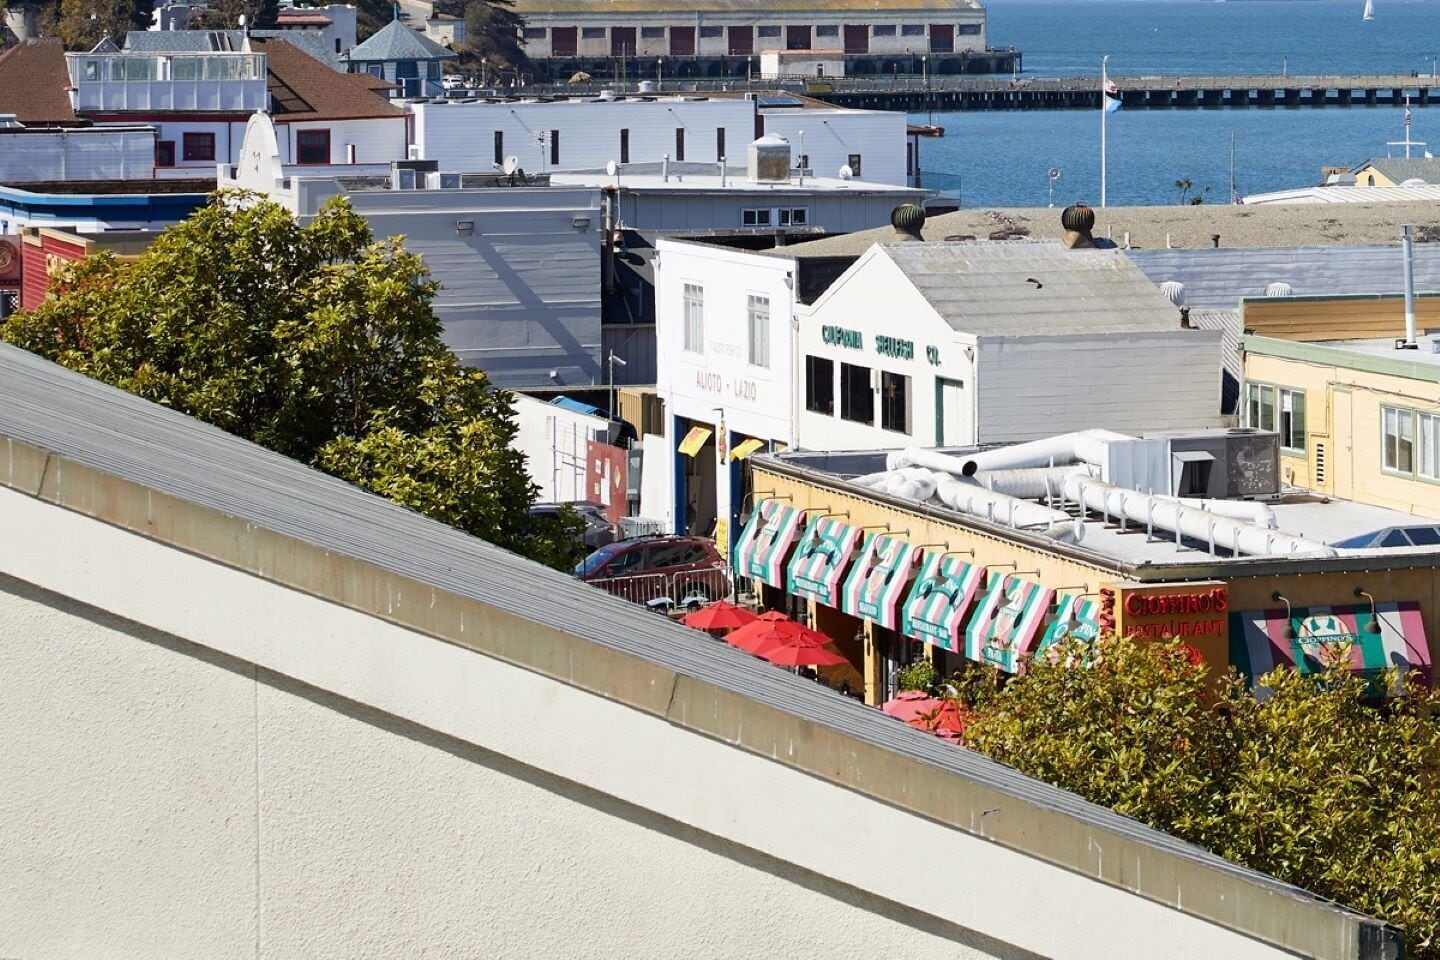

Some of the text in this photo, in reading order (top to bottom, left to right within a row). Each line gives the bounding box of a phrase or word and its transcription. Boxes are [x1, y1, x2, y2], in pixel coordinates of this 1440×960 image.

[822, 325, 863, 350] CALIFORNIA
[875, 335, 914, 360] SHELLFISH
[696, 370, 721, 393] ALIOTO
[734, 378, 757, 401] LAZIO
[1124, 588, 1229, 617] CIOPPINO'S
[1126, 620, 1226, 639] RESTAURANT
